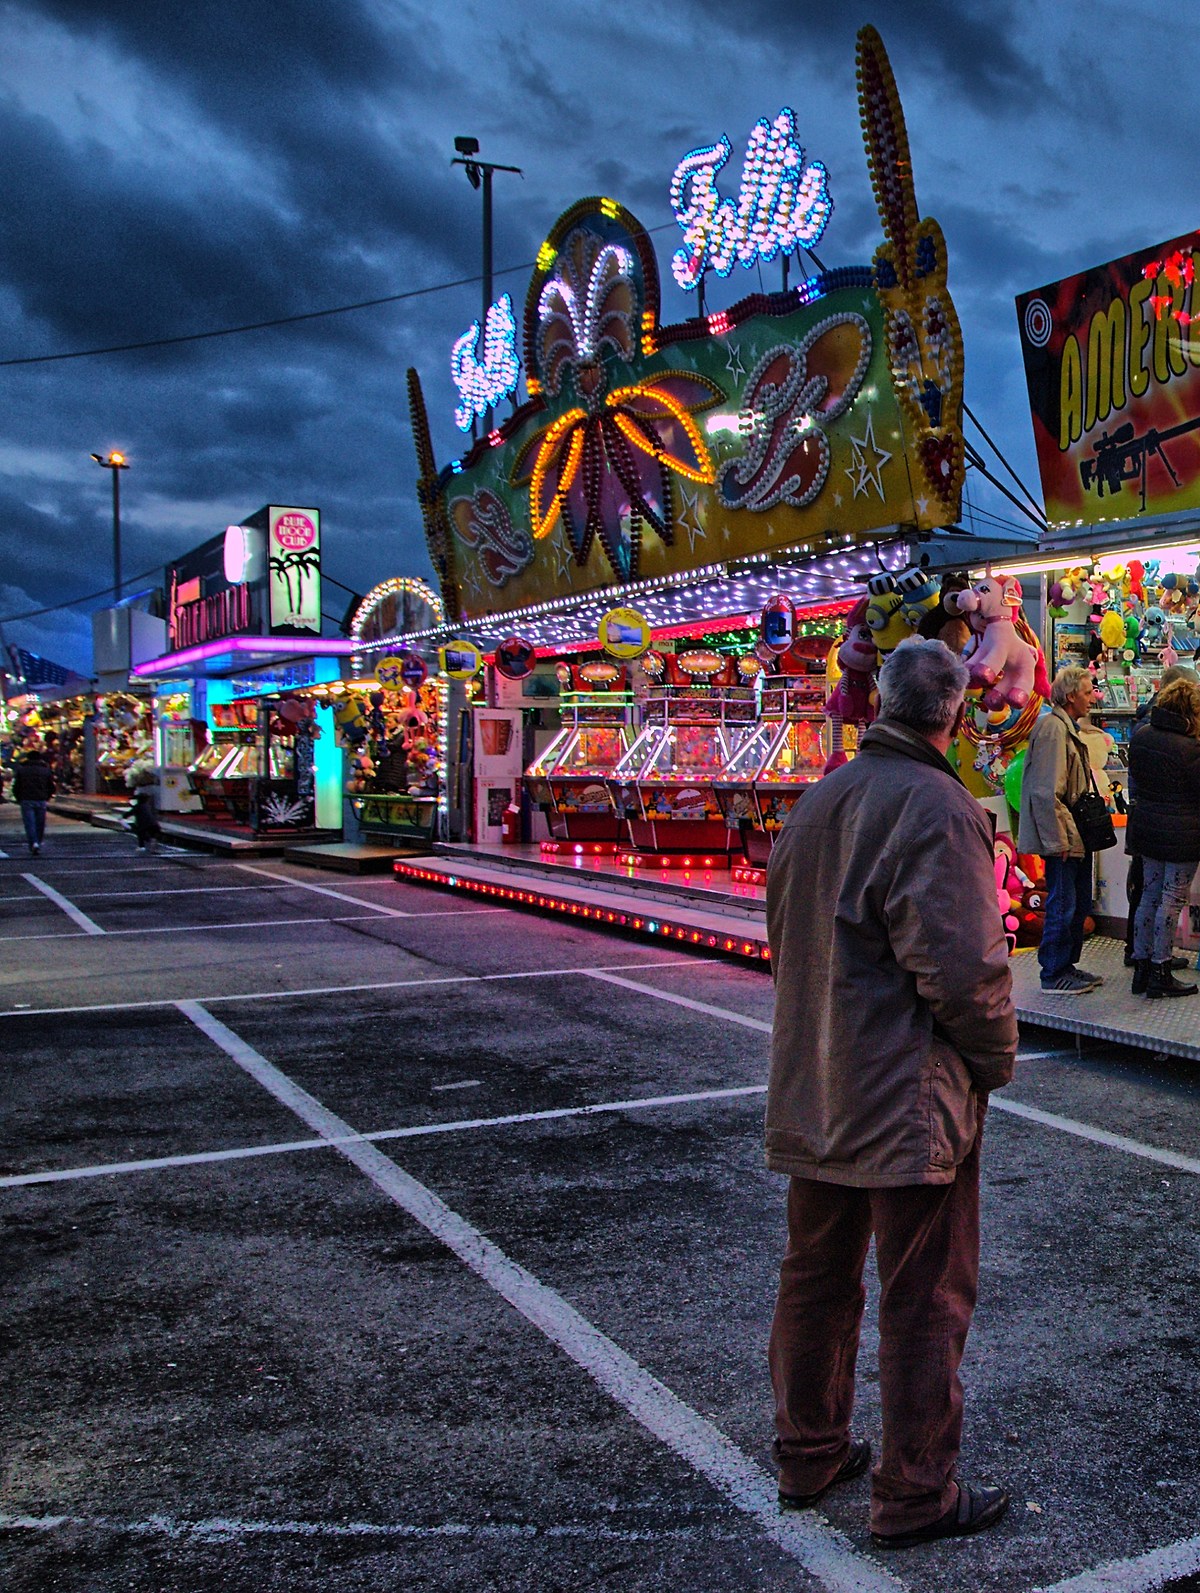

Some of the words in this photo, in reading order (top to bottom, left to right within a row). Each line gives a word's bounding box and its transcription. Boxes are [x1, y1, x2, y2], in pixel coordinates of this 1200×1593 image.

[283, 516, 305, 527] BLUE
[278, 525, 312, 537] MOON
[282, 536, 308, 547] CLUB
